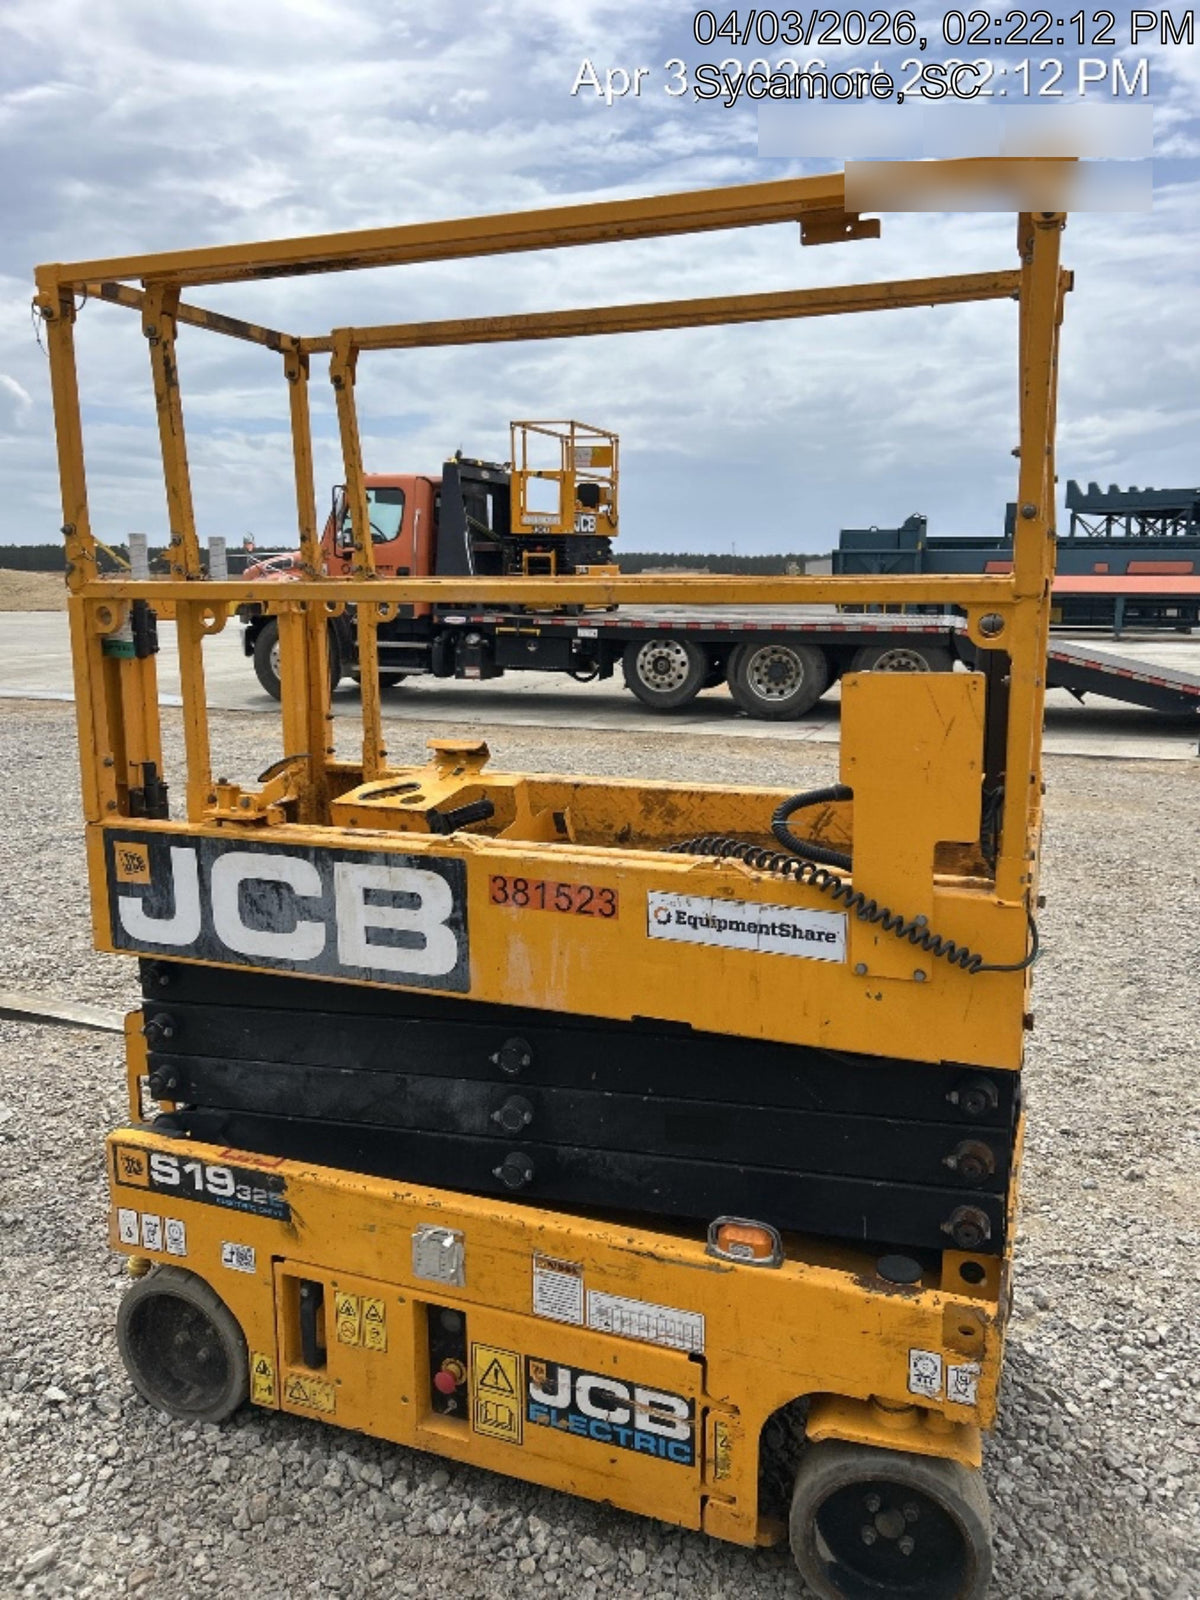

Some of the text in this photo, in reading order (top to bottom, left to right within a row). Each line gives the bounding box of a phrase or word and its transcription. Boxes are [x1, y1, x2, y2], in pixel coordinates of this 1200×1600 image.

[118, 846, 457, 976] JCB
[492, 875, 616, 918] 381523
[674, 909, 838, 944] EquipmentShare
[529, 1367, 691, 1441] JCB
